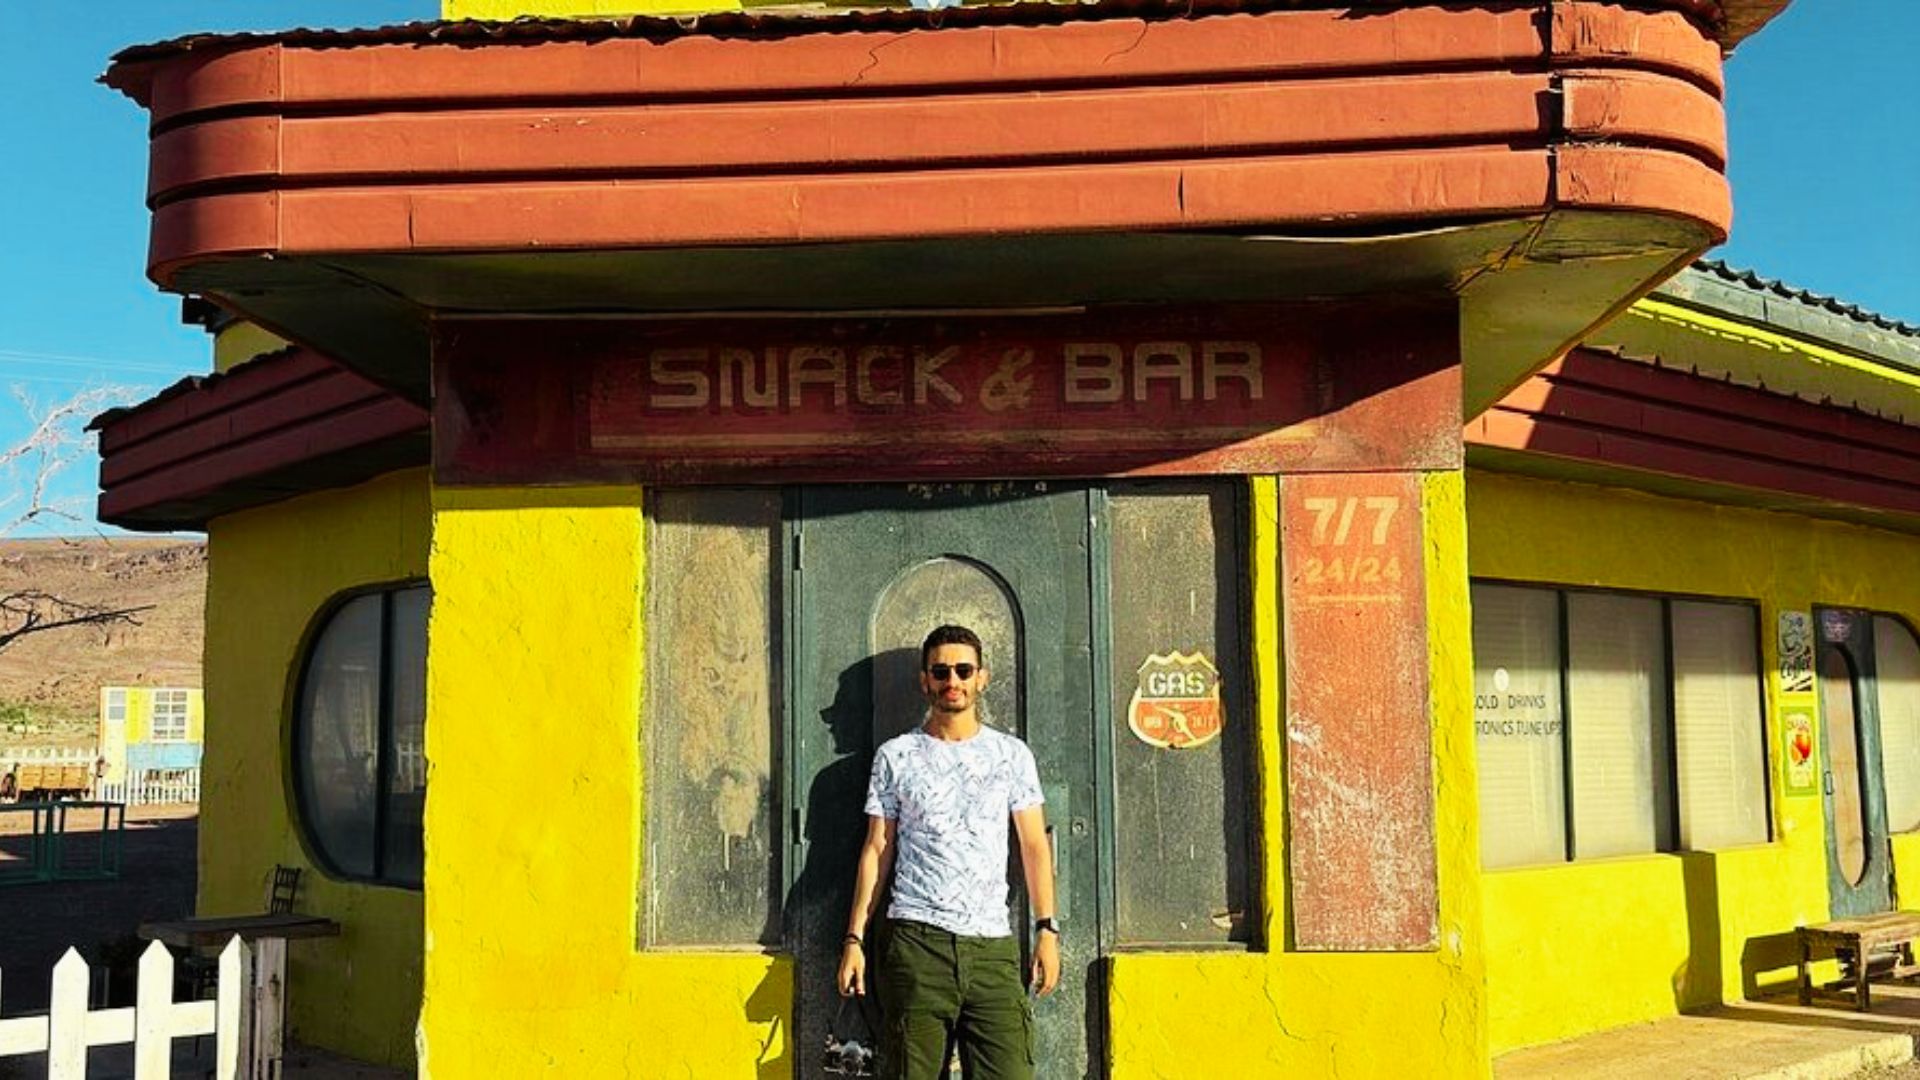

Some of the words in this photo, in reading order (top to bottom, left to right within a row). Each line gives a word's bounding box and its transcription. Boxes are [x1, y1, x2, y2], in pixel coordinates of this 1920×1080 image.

[649, 346, 963, 408] SNACK
[979, 347, 1034, 412] &
[1064, 341, 1263, 402] BAR
[1303, 495, 1400, 547] 7/7
[1305, 556, 1402, 584] 24/24
[1148, 671, 1205, 696] GAS
[1474, 694, 1499, 710] OLD
[1507, 694, 1546, 710] DRINKS
